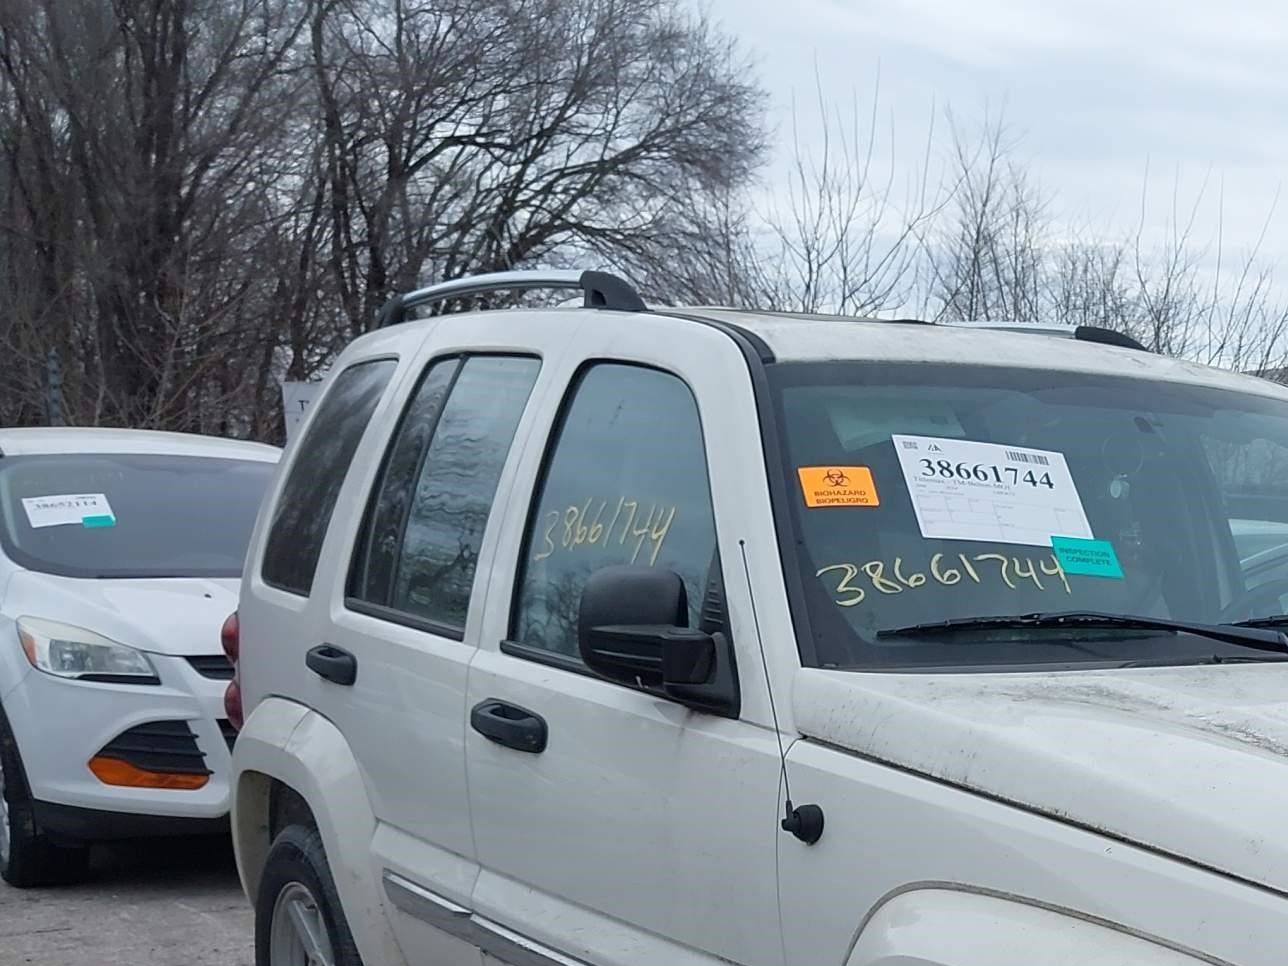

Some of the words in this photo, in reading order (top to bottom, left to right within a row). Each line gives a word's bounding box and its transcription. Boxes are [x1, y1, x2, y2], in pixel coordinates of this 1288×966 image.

[919, 457, 1055, 489] 38661744
[814, 489, 867, 497] BIOHAZARD
[815, 497, 869, 505] BIOPELIGRO
[533, 496, 676, 567] 38661744
[1059, 547, 1111, 558] INSPECTION
[1065, 555, 1111, 566] COMPLETE
[816, 553, 1072, 606] 38661744
